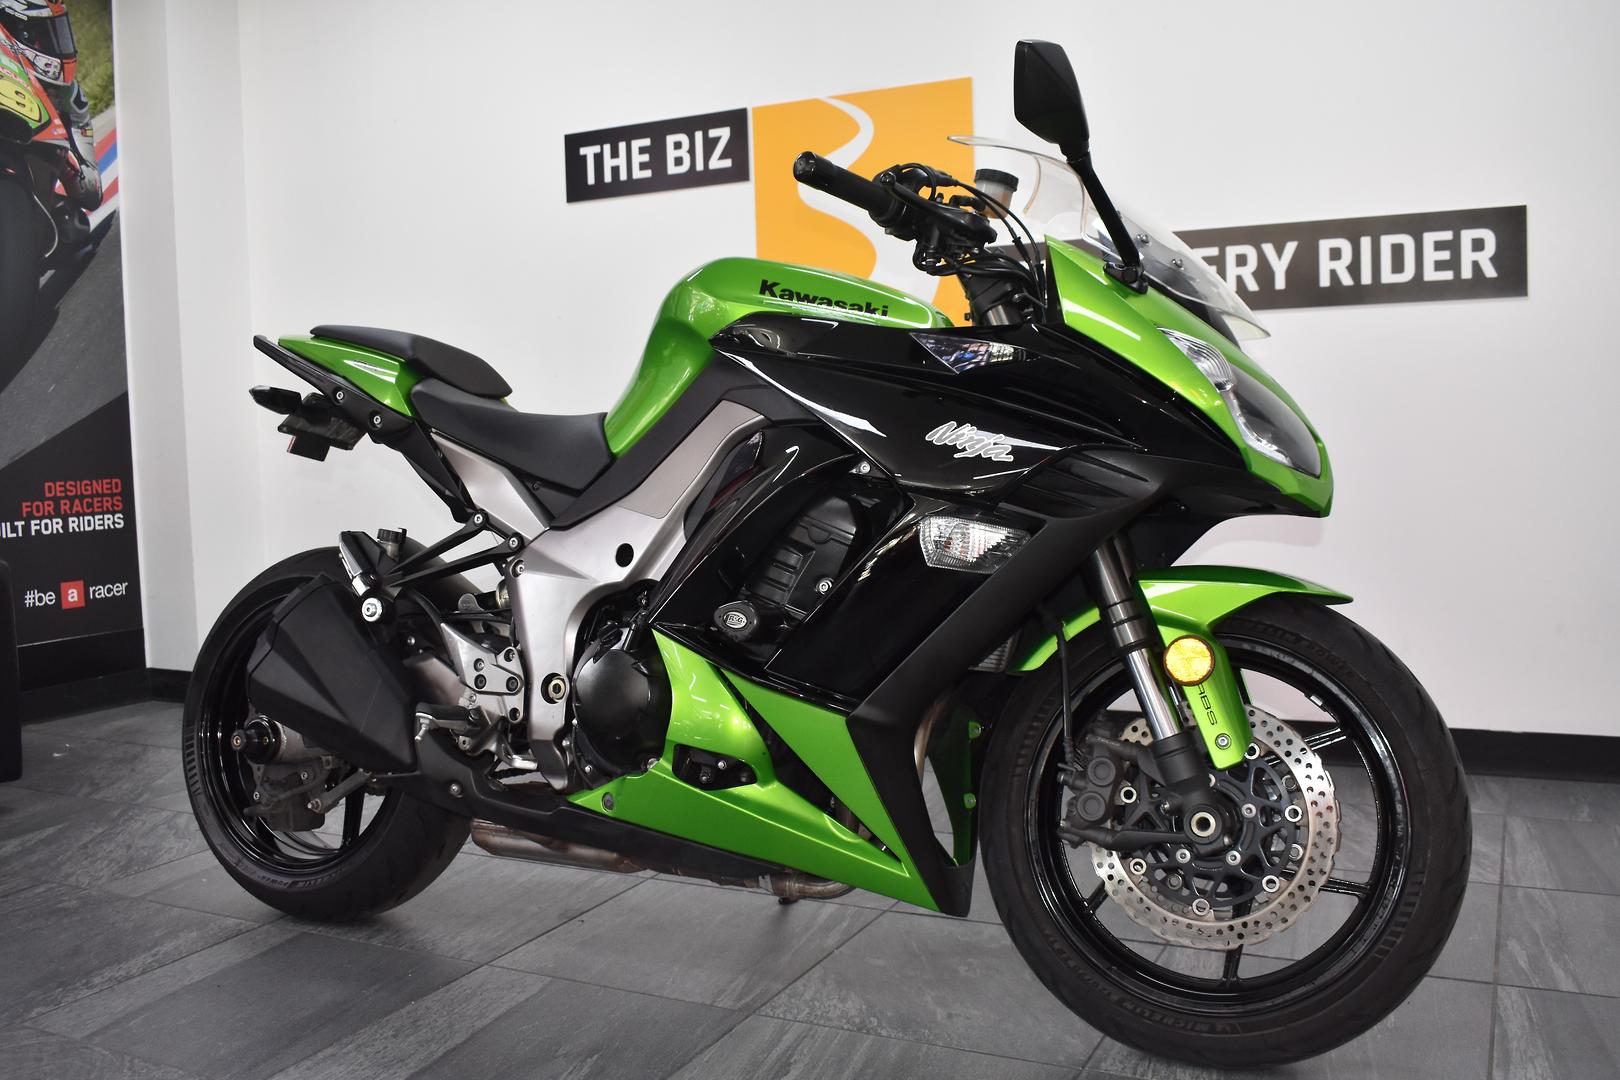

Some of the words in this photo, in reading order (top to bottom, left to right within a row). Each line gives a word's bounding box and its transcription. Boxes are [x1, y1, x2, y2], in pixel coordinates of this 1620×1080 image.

[579, 137, 653, 186] THE
[665, 126, 733, 175] BIZ
[1318, 228, 1499, 289] RIDER
[759, 279, 889, 317] Kawasaki
[925, 421, 1014, 462] Ninja
[44, 478, 122, 497] DESIGNED
[22, 502, 54, 517] FOR
[60, 497, 123, 515] RACERS
[0, 522, 25, 539] ILT
[30, 518, 64, 536] FOR
[68, 514, 125, 532] RIDERS
[24, 589, 56, 608] #be
[67, 587, 78, 602] a
[89, 581, 129, 600] racer
[1197, 683, 1218, 726] ABS
